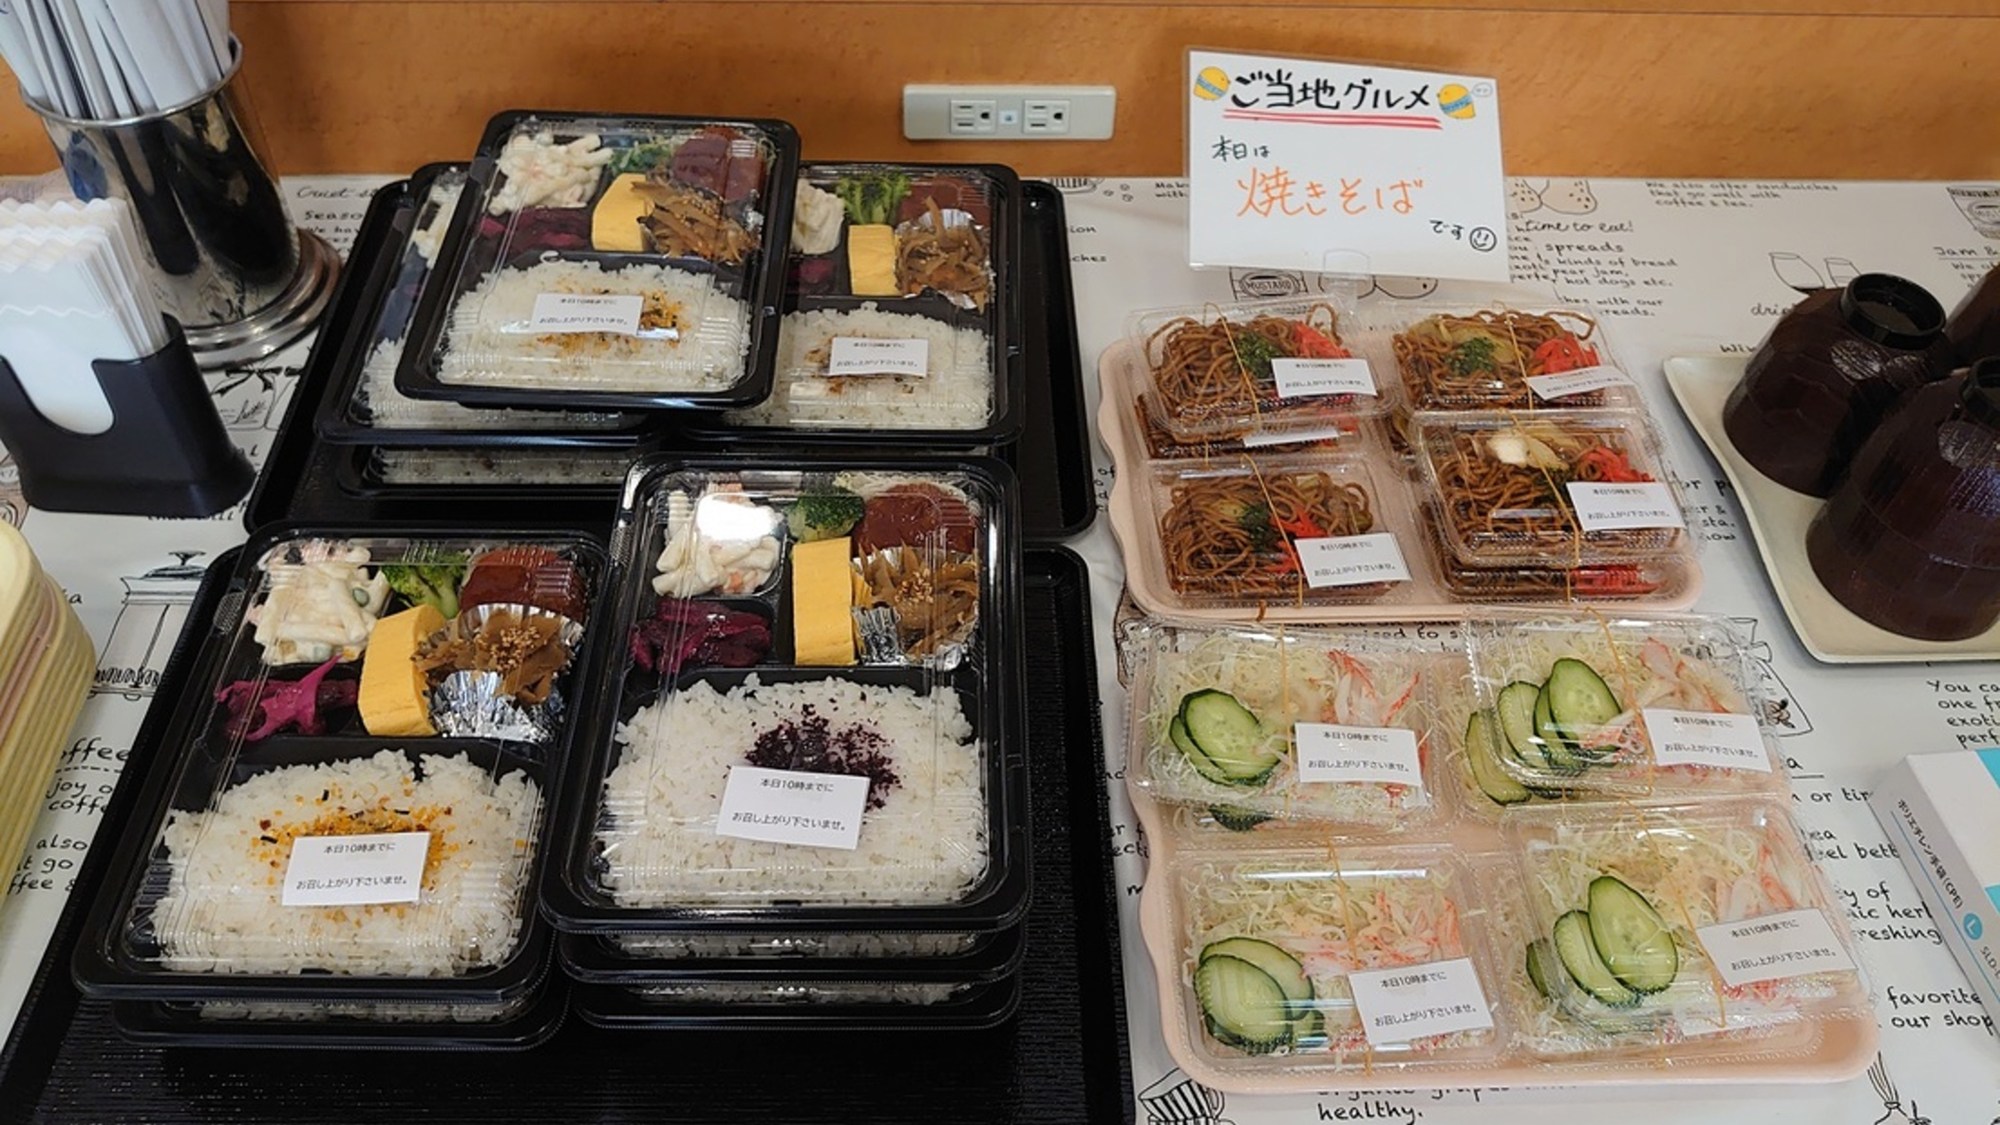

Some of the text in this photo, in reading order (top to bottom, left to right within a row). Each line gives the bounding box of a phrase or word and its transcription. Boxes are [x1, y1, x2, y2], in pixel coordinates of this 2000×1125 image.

[1231, 68, 1430, 110] ご当地グルメ
[1211, 135, 1270, 162] 本日は
[1236, 165, 1424, 218] 焼きそば
[1429, 218, 1465, 241] です
[1926, 679, 1972, 693] You
[1938, 699, 1977, 709] one
[760, 777, 836, 793] 本日10時までに
[1810, 791, 1832, 803] or
[323, 841, 397, 855] 本日10時までに
[1866, 880, 1890, 902] of
[1887, 985, 1983, 1010] favorite
[1891, 1013, 1931, 1029] our
[1317, 1101, 1424, 1125] healthy.
